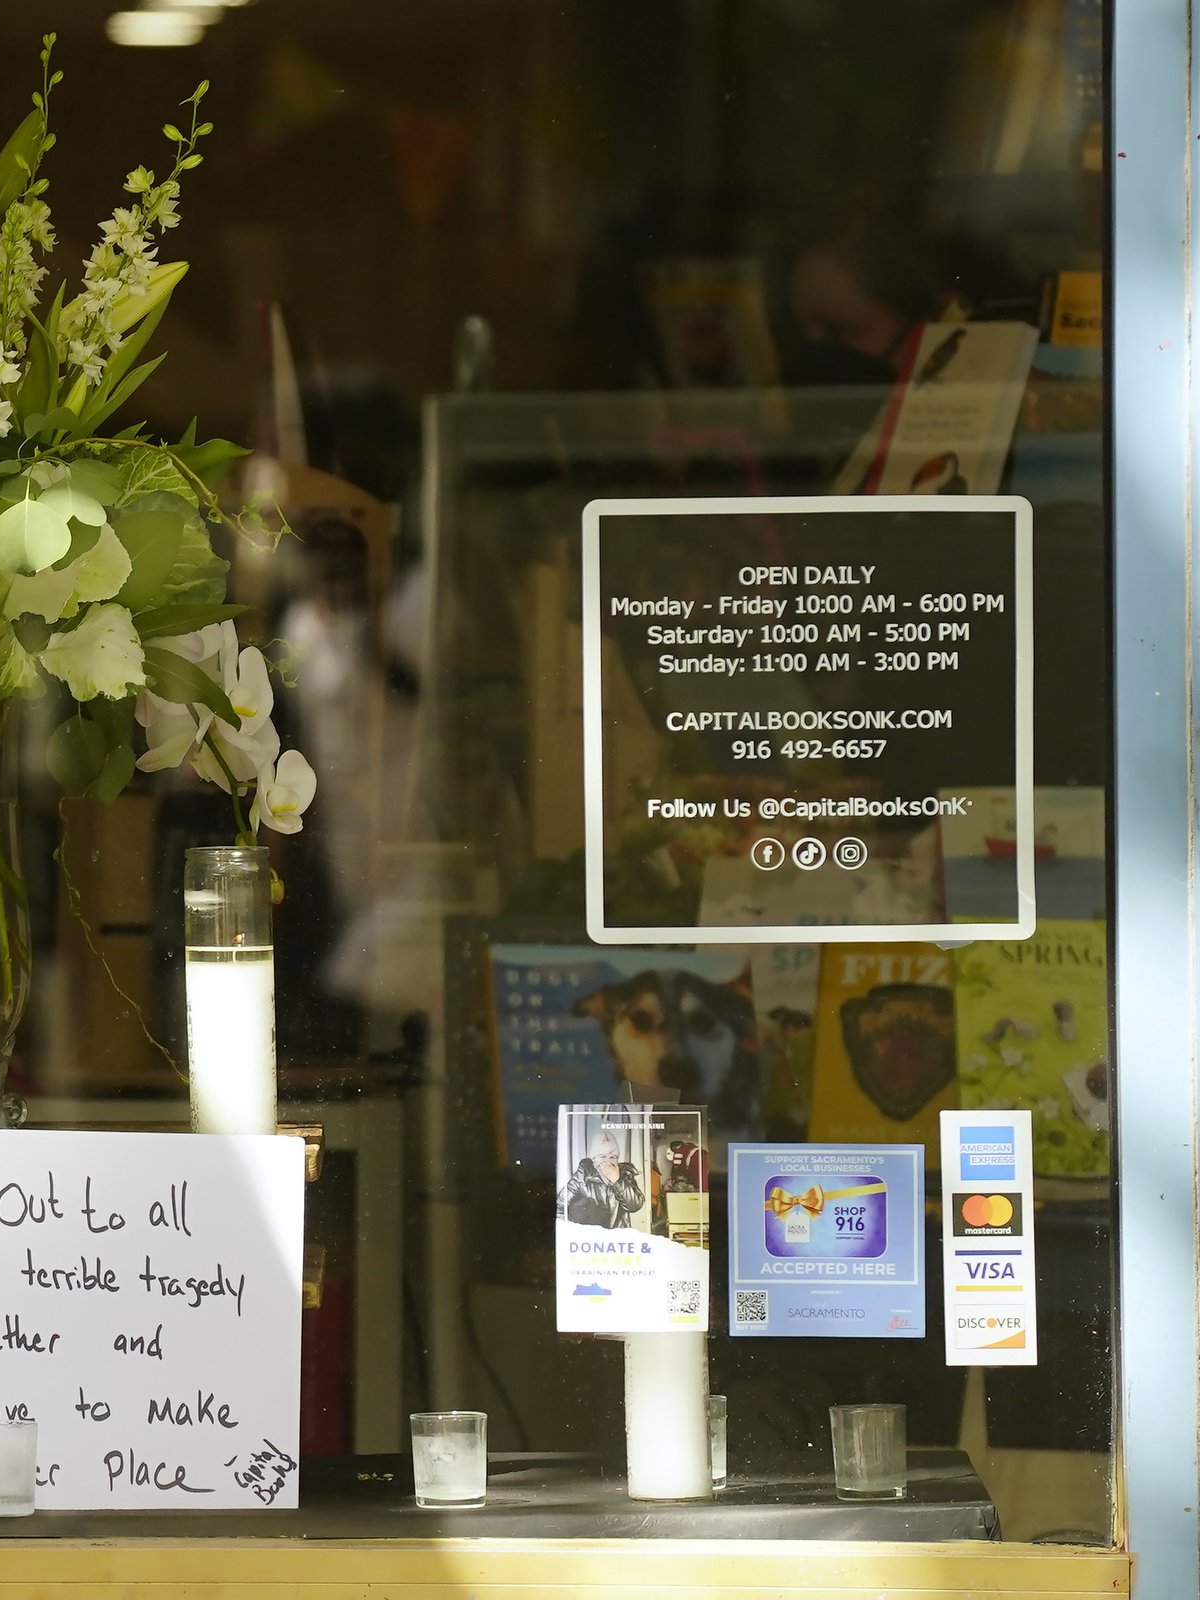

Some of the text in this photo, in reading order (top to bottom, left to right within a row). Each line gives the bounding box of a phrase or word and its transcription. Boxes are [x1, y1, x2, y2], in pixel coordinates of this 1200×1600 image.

[738, 565, 876, 586] OPEN DAILY
[611, 596, 695, 620] Monday
[719, 595, 788, 619] Friday
[795, 594, 853, 614] 10:00
[861, 594, 896, 614] AM
[919, 593, 967, 613] 6:00
[972, 593, 1005, 613] PM
[760, 623, 819, 644] 10:00
[826, 623, 861, 643] AM
[885, 622, 932, 643] 5:00
[938, 622, 970, 642] PM
[659, 653, 746, 677] Sunday:
[815, 652, 850, 672] AM
[874, 651, 921, 672] 3:00
[927, 651, 959, 671] PM
[666, 709, 952, 732] CAPITALBOOKSONK.COM
[731, 739, 887, 760] 916 492-6657
[647, 798, 717, 819] Follow
[723, 798, 752, 818] Us
[960, 1144, 1011, 1152] AMERICAN
[764, 1156, 884, 1164] SUPPORT SACRAMENTO'S
[971, 1155, 1016, 1164] EXPRESS
[813, 1165, 871, 1173] BUSINESSES
[81, 1176, 126, 1234] to
[149, 1180, 192, 1237] all
[834, 1206, 866, 1216] SHOP
[835, 1216, 865, 1231] 916
[964, 1226, 1013, 1235] mastercard
[569, 1242, 652, 1254] DONATE &
[760, 1262, 896, 1275] ACCEPTED HERE
[963, 1262, 1016, 1279] VISA
[20, 1248, 120, 1293] terrible
[138, 1255, 245, 1317] tragedy
[787, 1308, 866, 1319] SACRAMENTO
[958, 1317, 1021, 1329] DISCOVER
[113, 1323, 163, 1361] and
[74, 1386, 111, 1422] to
